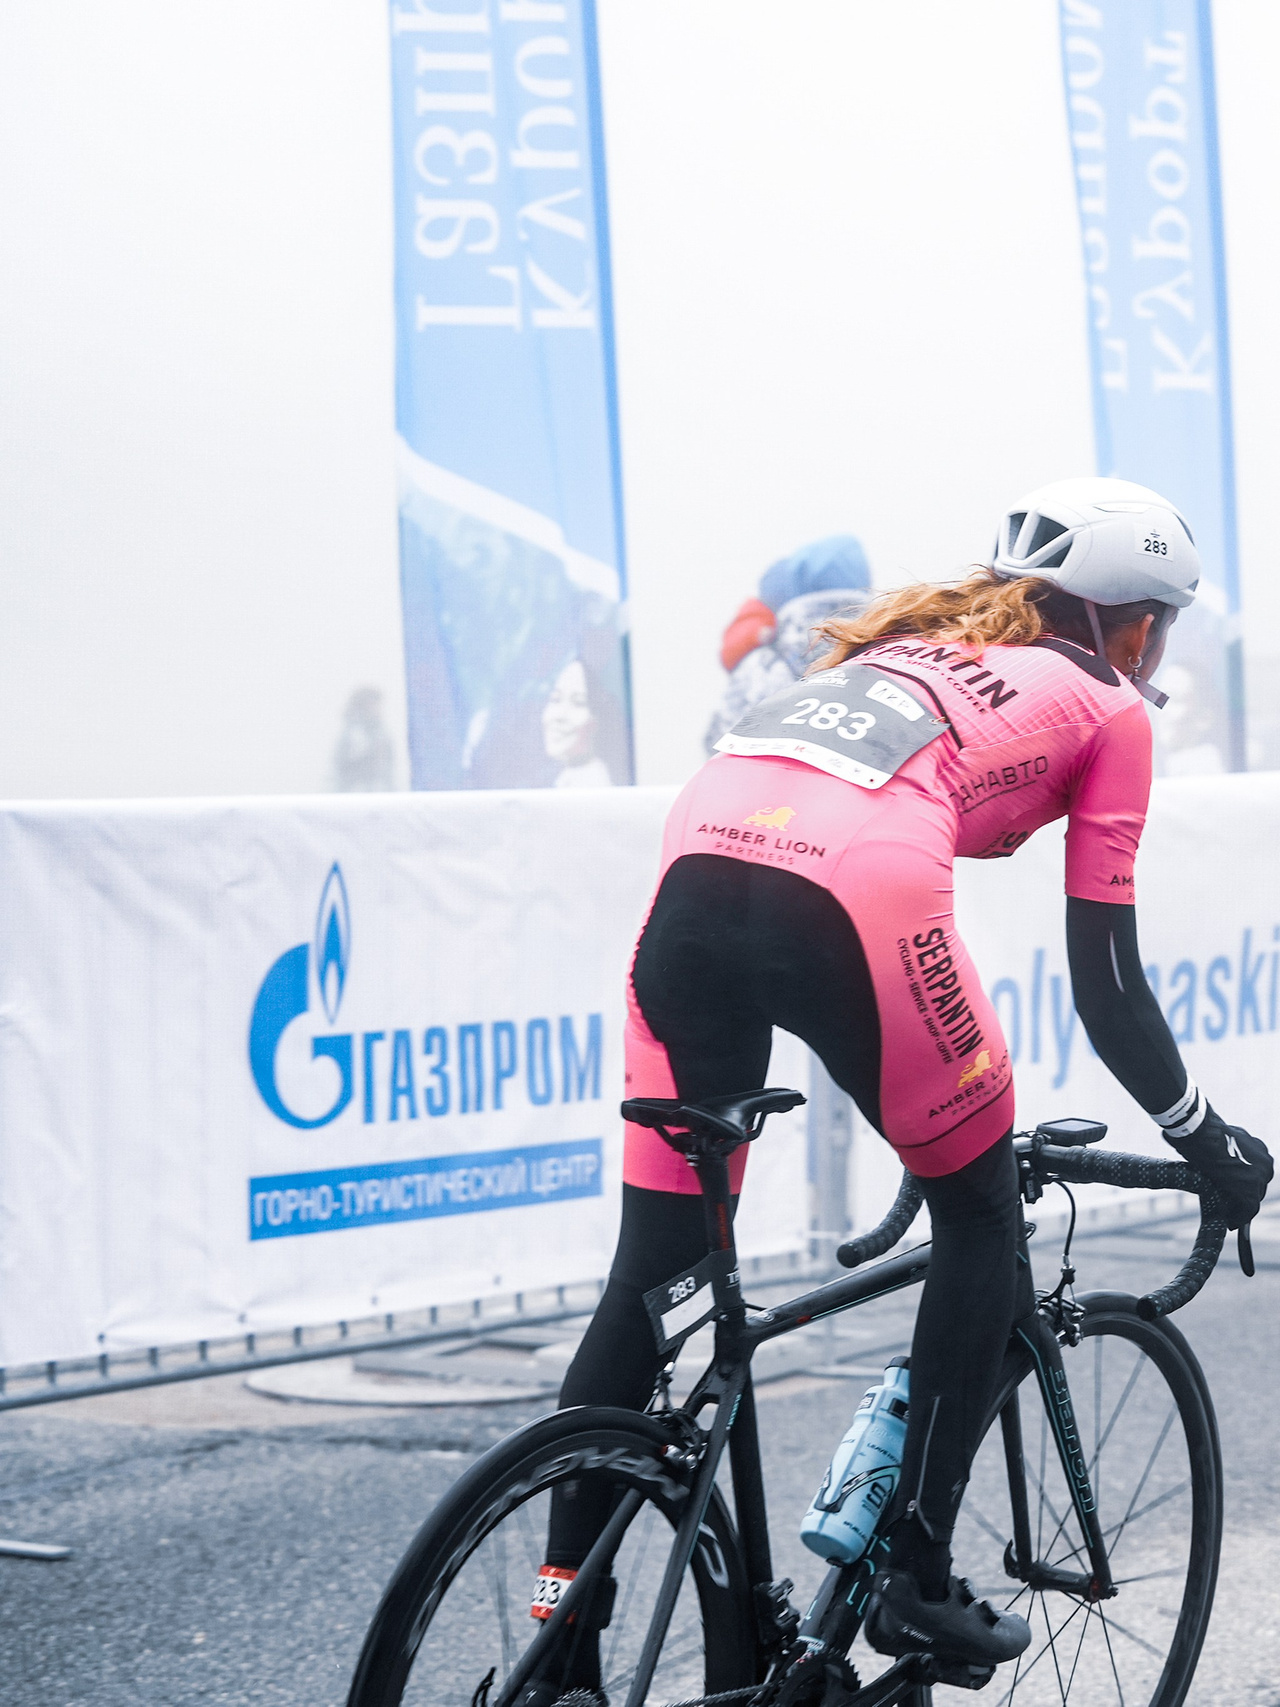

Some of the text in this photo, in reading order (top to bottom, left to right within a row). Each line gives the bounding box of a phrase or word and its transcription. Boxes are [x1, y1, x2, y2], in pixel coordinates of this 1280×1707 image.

[1143, 538, 1168, 556] 283
[946, 676, 988, 715] COFFEE
[780, 697, 877, 741] 283
[696, 823, 827, 858] AMBER LION
[715, 841, 796, 865] PARTNERS
[897, 937, 955, 1065] CYCLING SERVICE SHOP COFFEE
[913, 927, 985, 1059] SERPANTIN
[361, 1011, 605, 1125] ГАЗПРОМ
[928, 1080, 986, 1119] AMBER
[253, 1152, 599, 1228] ГОРНО-ТУРИСТИЧЕСКИЙ ЦЕНТР
[667, 1276, 697, 1304] 283
